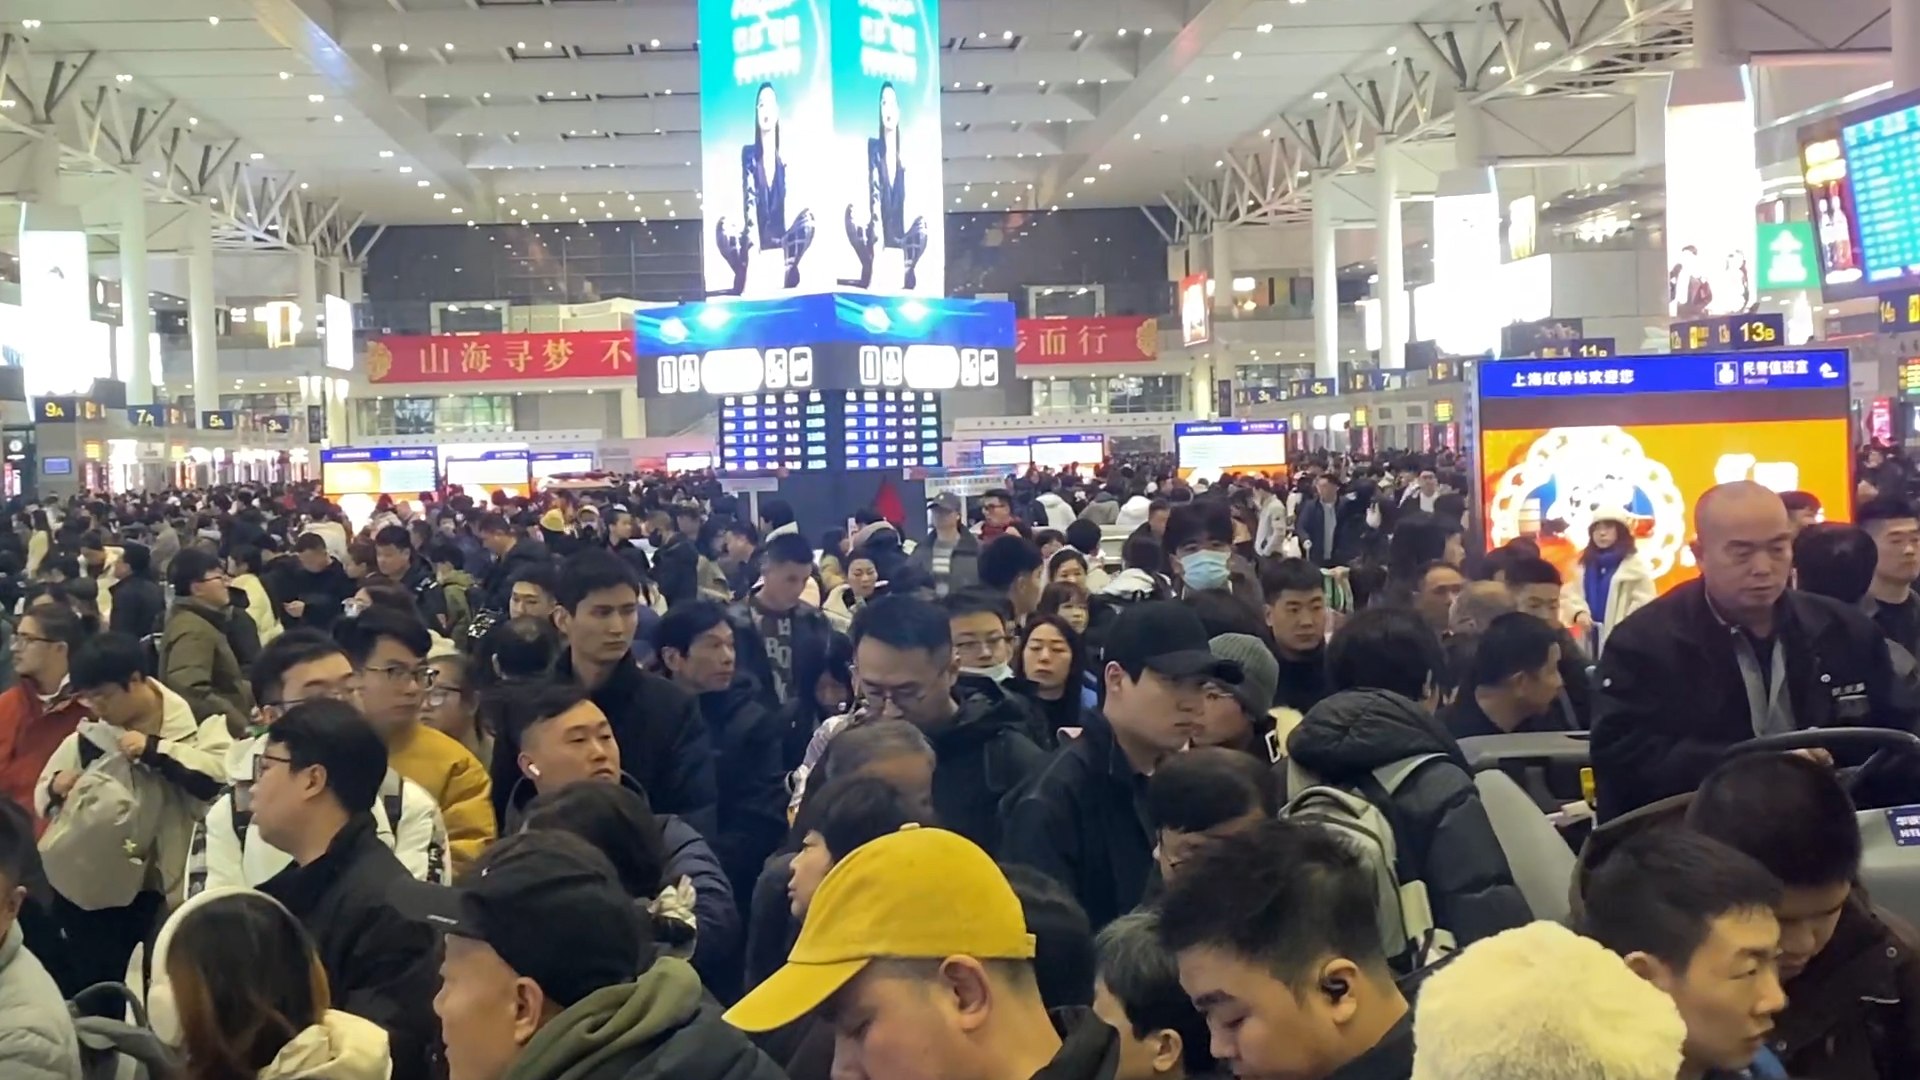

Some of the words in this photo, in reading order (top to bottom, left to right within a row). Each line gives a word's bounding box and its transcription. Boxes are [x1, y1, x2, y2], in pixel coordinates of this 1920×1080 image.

[1740, 322, 1775, 342] 13B
[419, 339, 575, 374] 山海寻梦
[600, 337, 632, 370] 不
[45, 402, 64, 417] 9A
[209, 415, 225, 428] 5A
